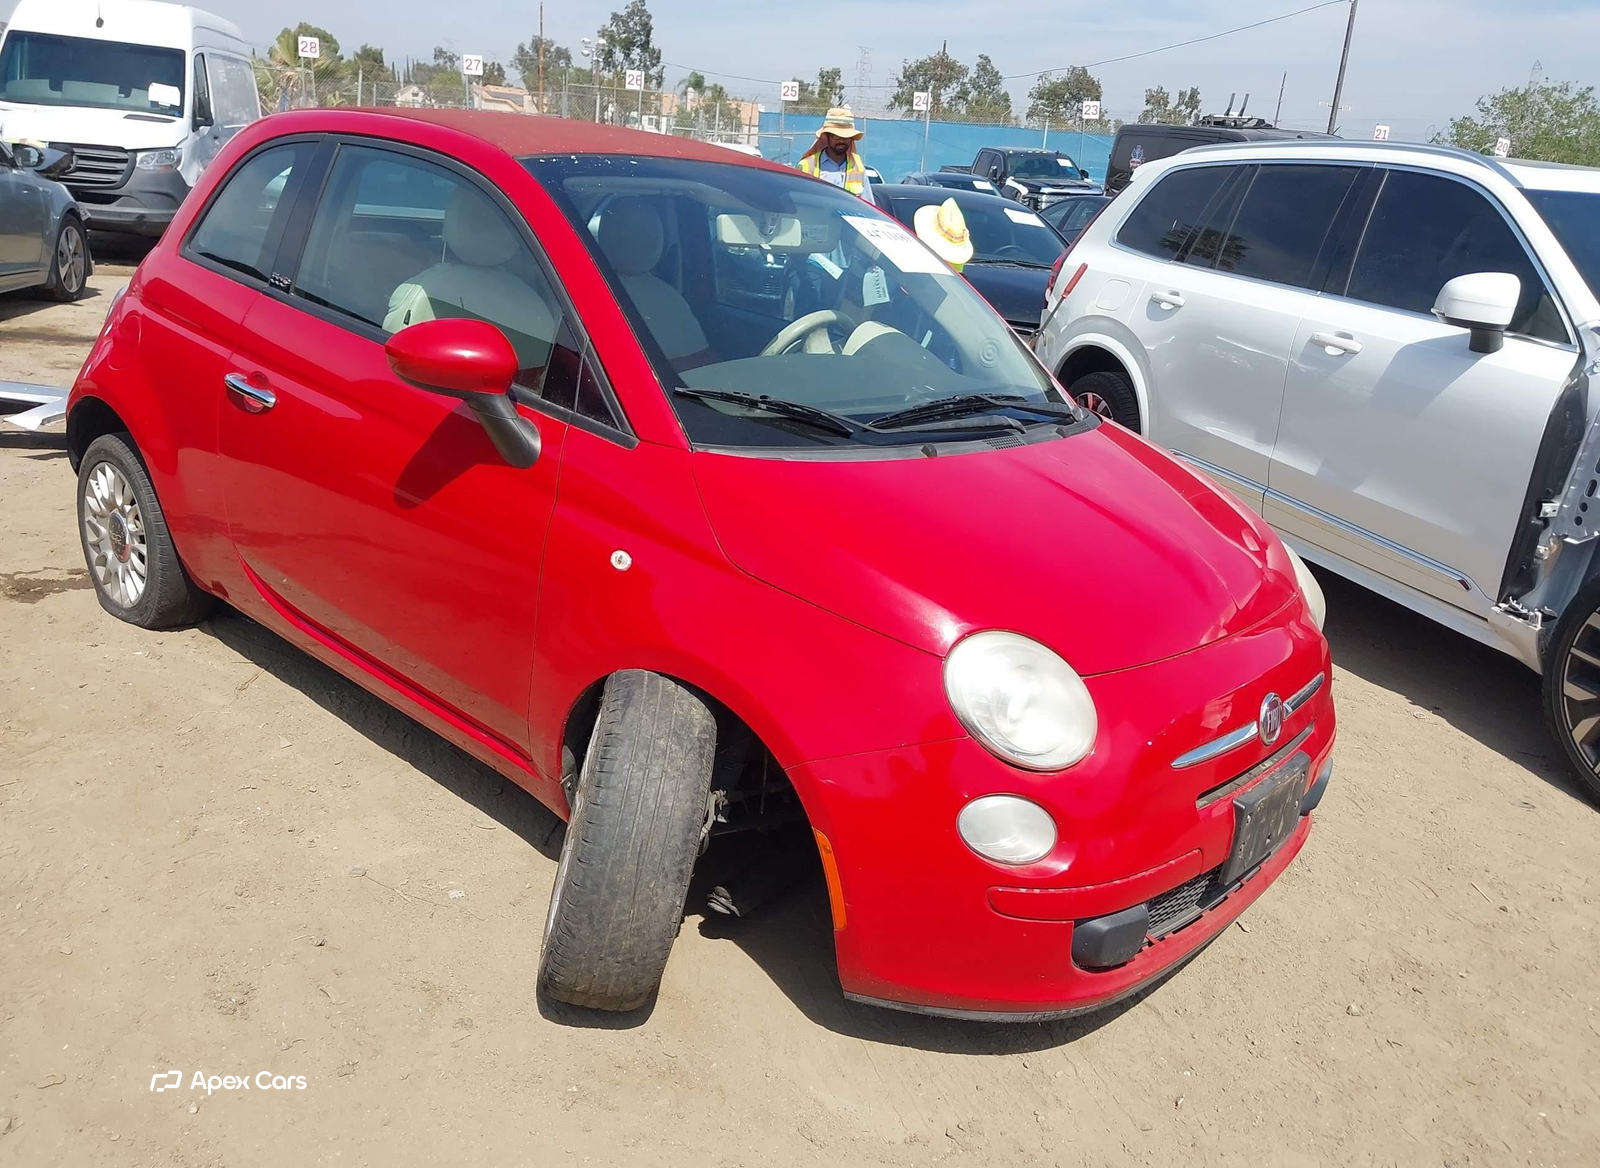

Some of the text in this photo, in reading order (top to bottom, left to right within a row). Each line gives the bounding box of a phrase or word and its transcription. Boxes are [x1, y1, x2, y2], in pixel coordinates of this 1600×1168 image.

[300, 40, 318, 54] 28
[465, 58, 481, 71] 27
[627, 73, 643, 87] 26
[782, 85, 798, 98] 25
[914, 95, 929, 107] 24
[1083, 104, 1099, 116] 23
[1374, 128, 1387, 140] 21
[1496, 140, 1509, 153] 20
